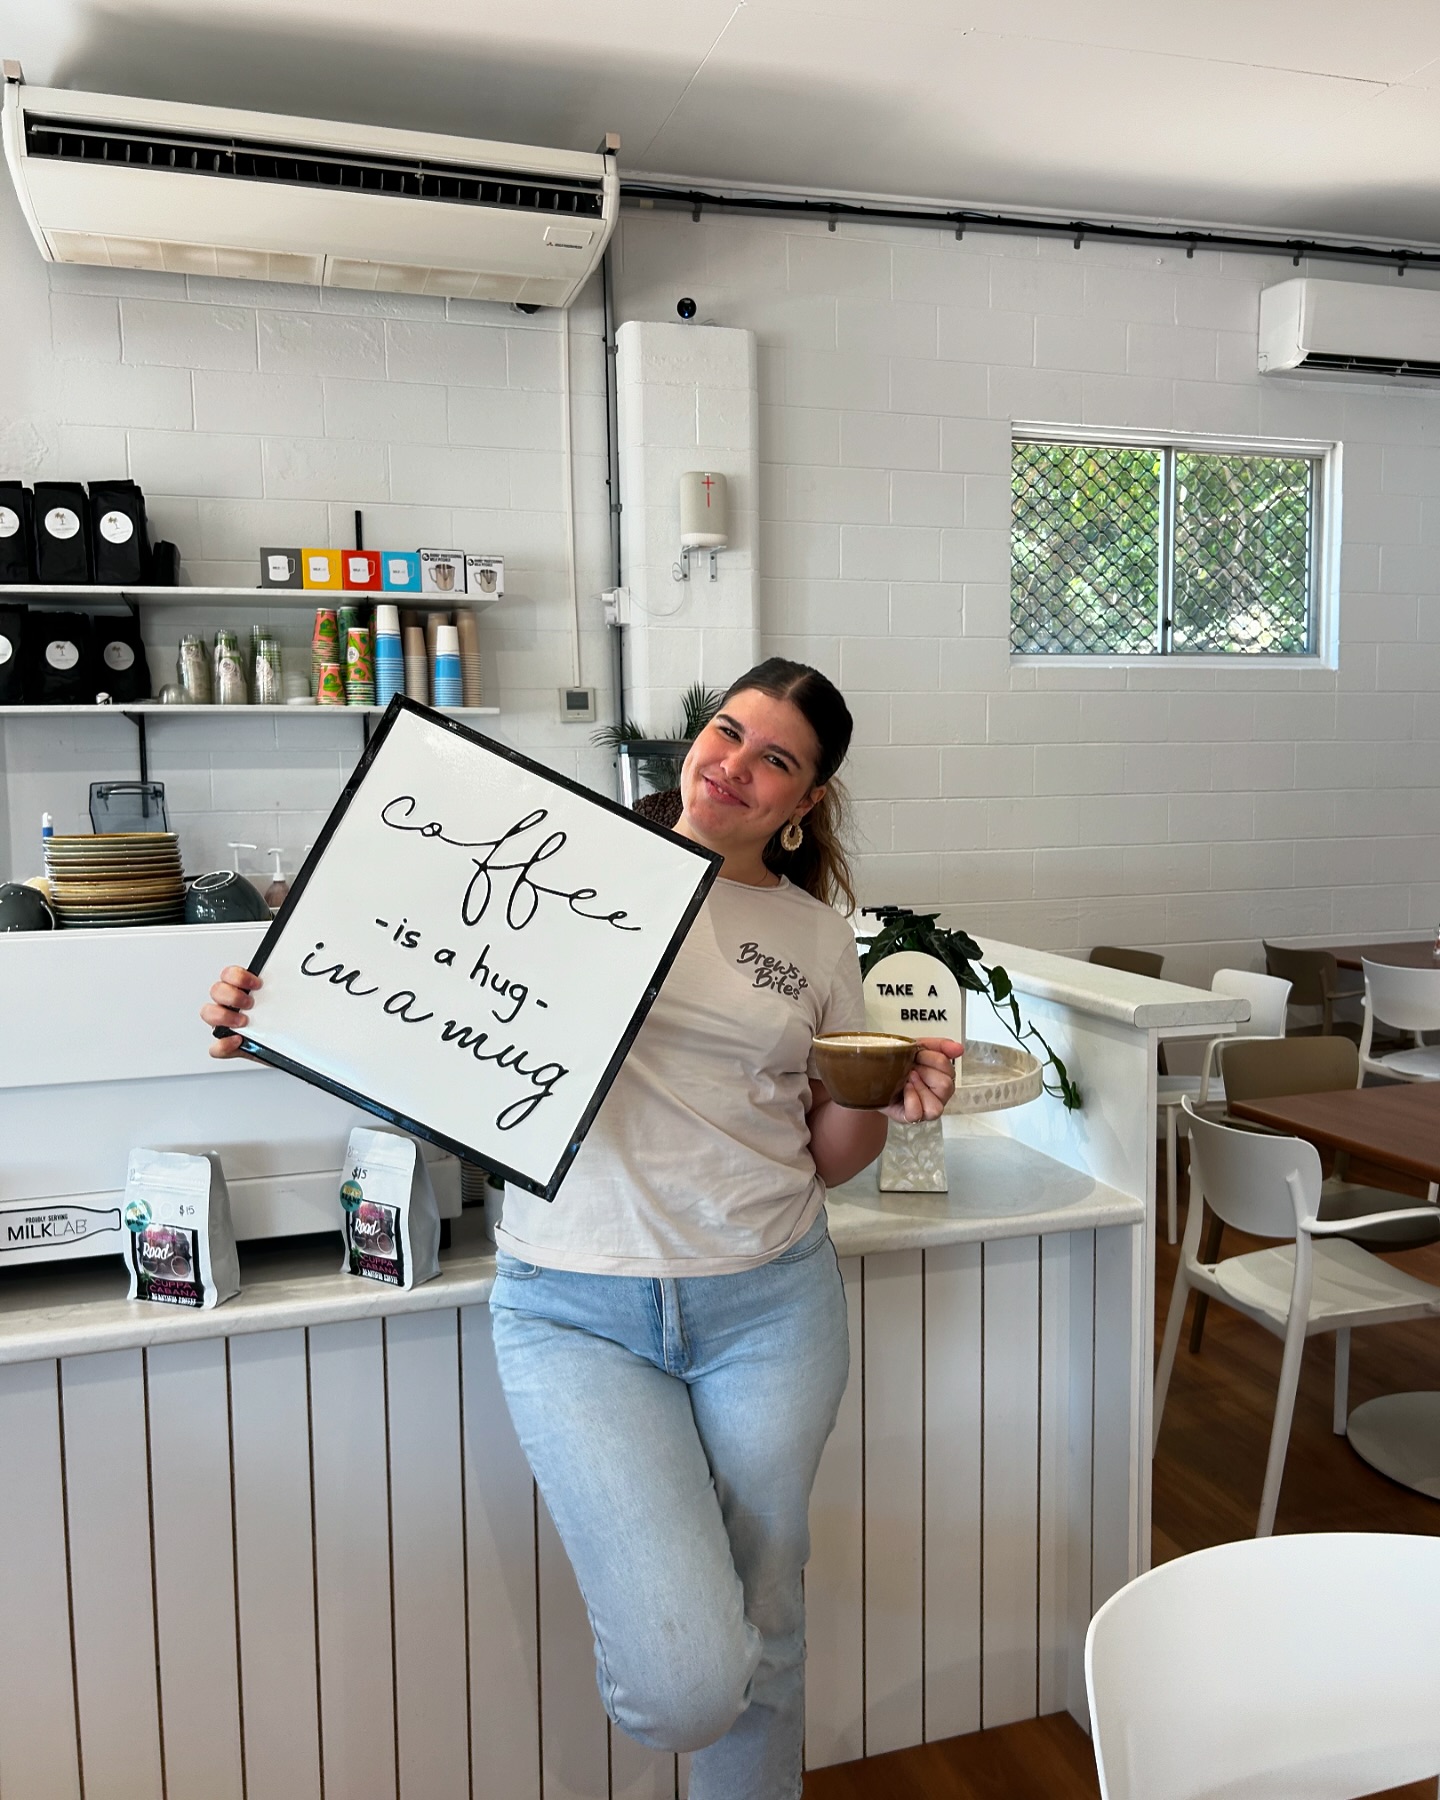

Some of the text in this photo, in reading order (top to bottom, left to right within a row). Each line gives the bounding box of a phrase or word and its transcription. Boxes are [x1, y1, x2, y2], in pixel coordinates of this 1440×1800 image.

[381, 795, 642, 931] coffee
[434, 947, 455, 966] a
[736, 942, 800, 979] Brews
[752, 967, 800, 1000] Bites
[877, 983, 938, 997] TAKE A
[901, 1008, 947, 1021] BREAK
[300, 942, 569, 1131] in a mug
[351, 1166, 368, 1180] $15
[179, 1204, 195, 1216] $15
[25, 1213, 68, 1224] PROUDLY SERVING
[7, 1219, 87, 1241] MILKLAB
[362, 1254, 394, 1267] CUPPA
[359, 1260, 399, 1276] CABANA
[149, 1285, 198, 1297] CABANA
[153, 1278, 192, 1290] CUPPA
